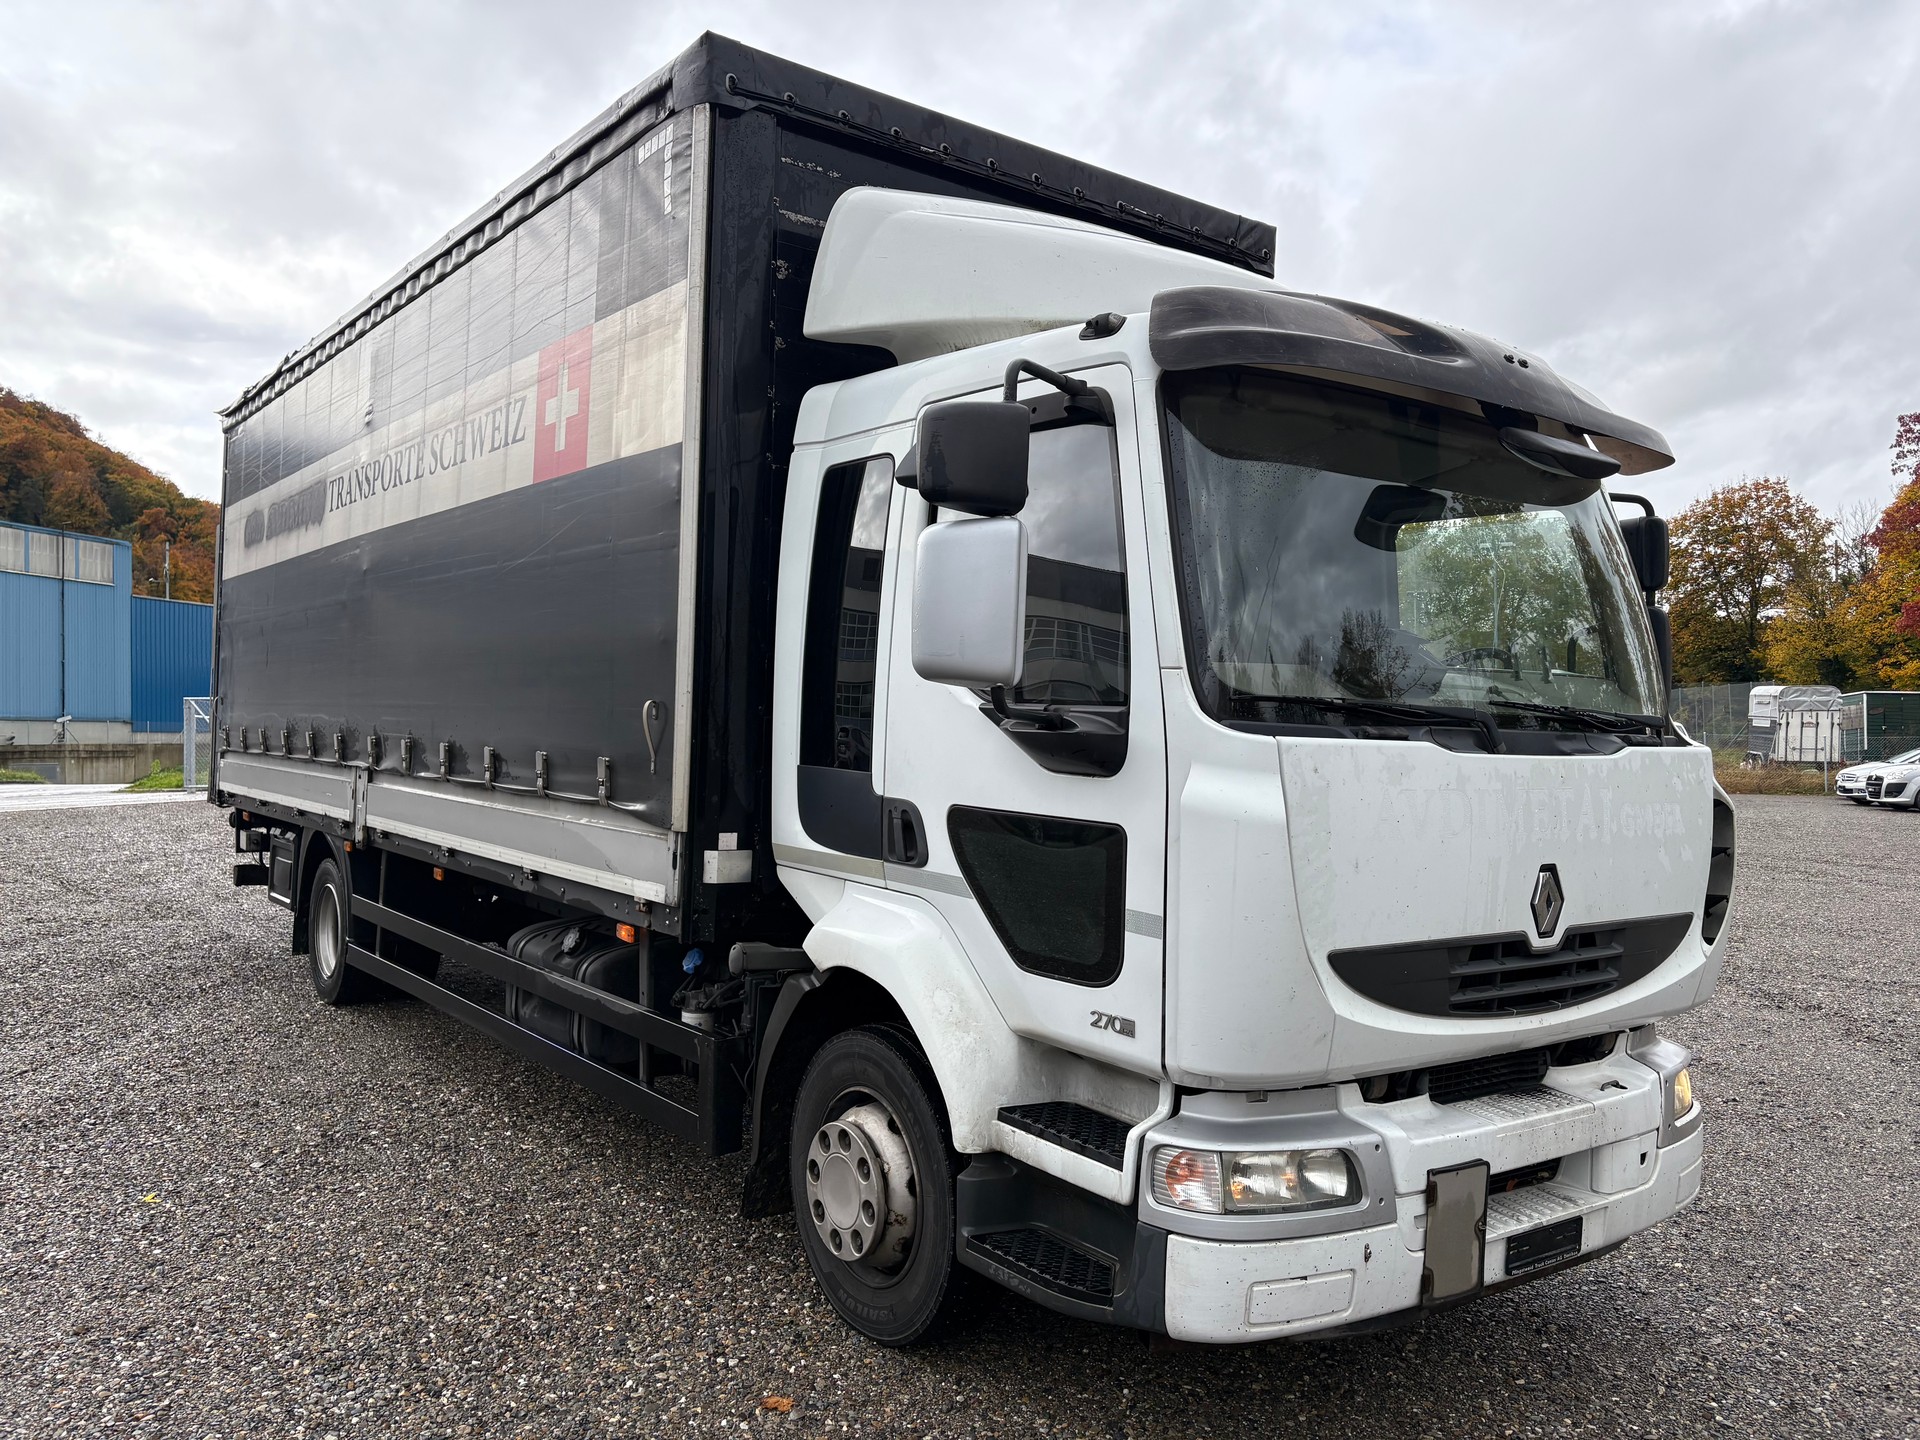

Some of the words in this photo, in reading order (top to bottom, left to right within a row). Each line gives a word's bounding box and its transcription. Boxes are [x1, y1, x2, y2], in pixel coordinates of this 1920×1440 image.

[329, 439, 426, 513] TRANSPORTE
[429, 395, 527, 476] SCHWEIZ
[1090, 1010, 1121, 1034] 270
